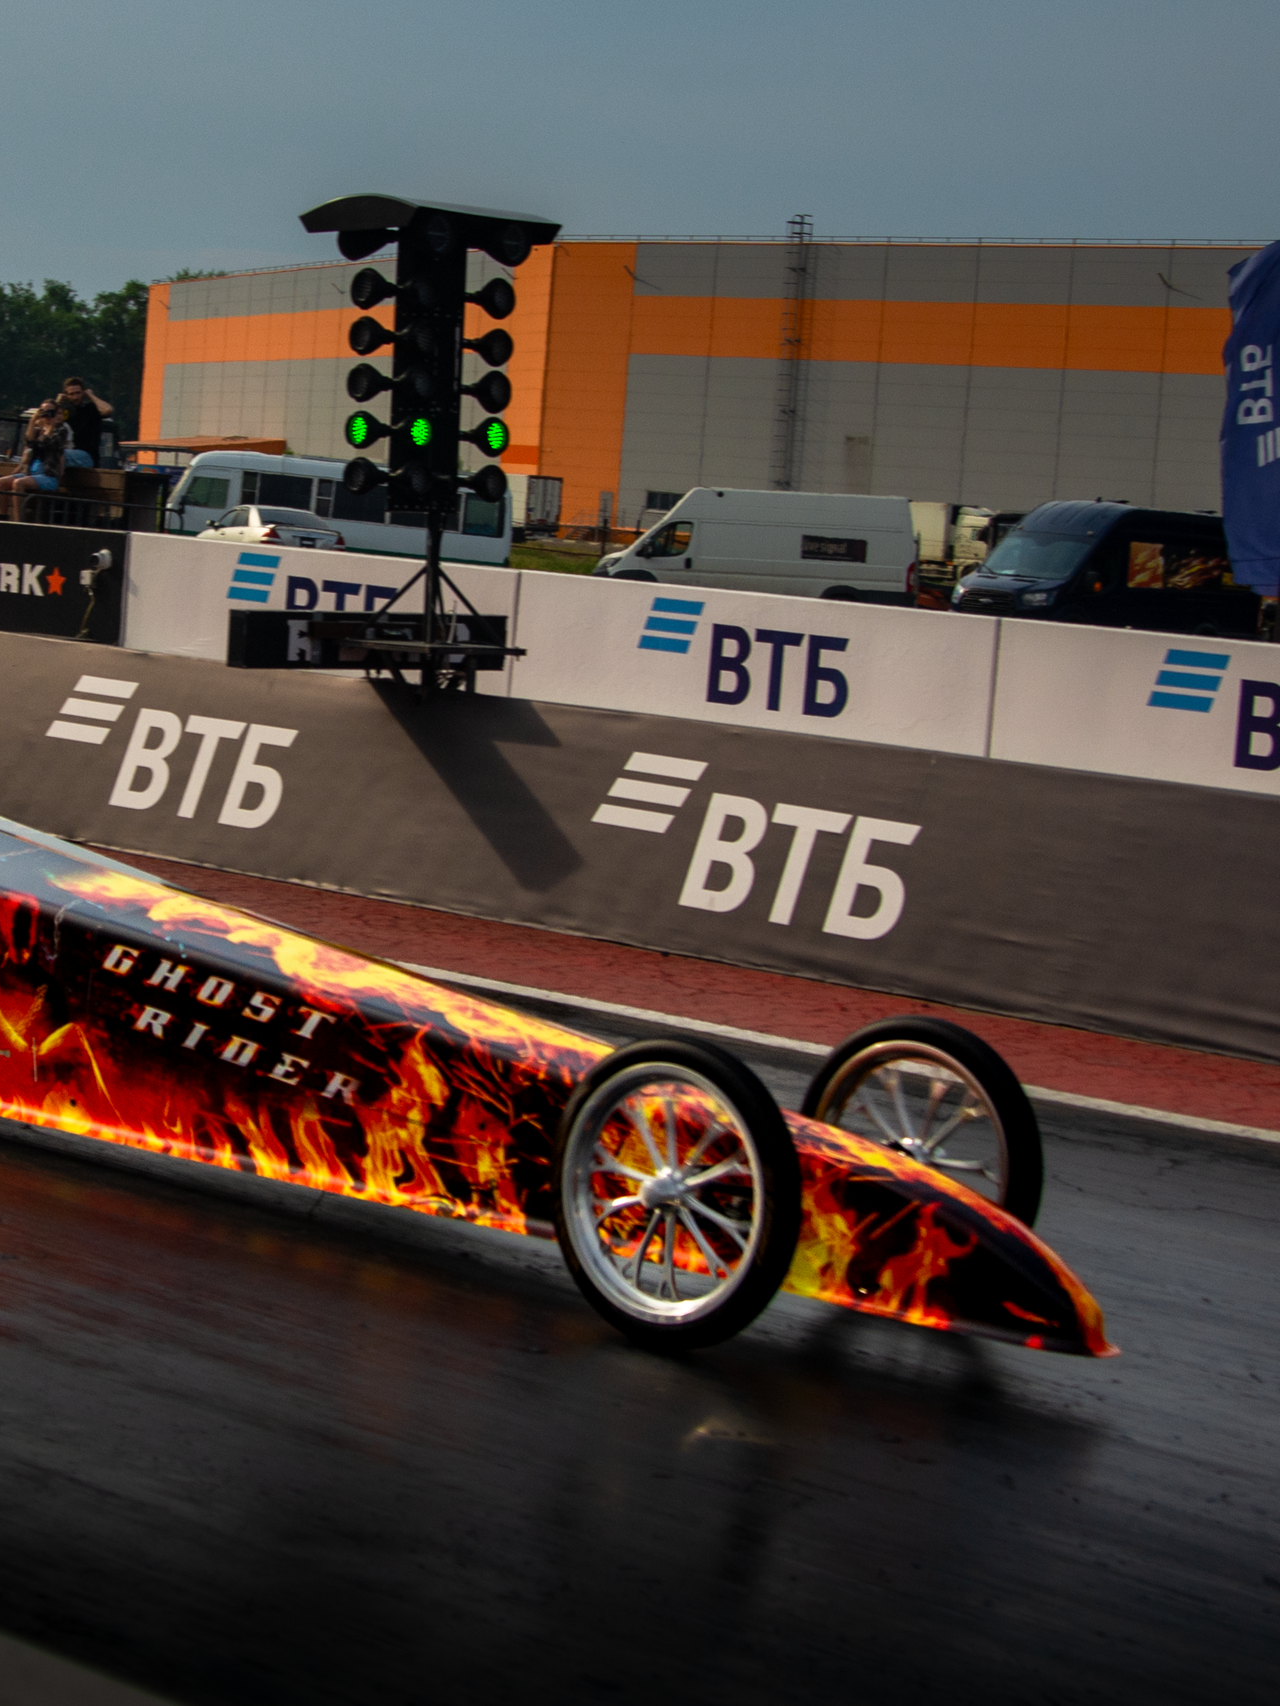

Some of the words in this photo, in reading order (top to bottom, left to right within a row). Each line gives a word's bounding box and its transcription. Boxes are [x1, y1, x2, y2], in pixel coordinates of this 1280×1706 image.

[705, 622, 851, 719] ВТБ
[108, 707, 299, 829] ВТБ
[678, 792, 922, 940] ВТБ
[102, 944, 337, 1039] GHOST
[133, 1005, 361, 1106] RIDER
